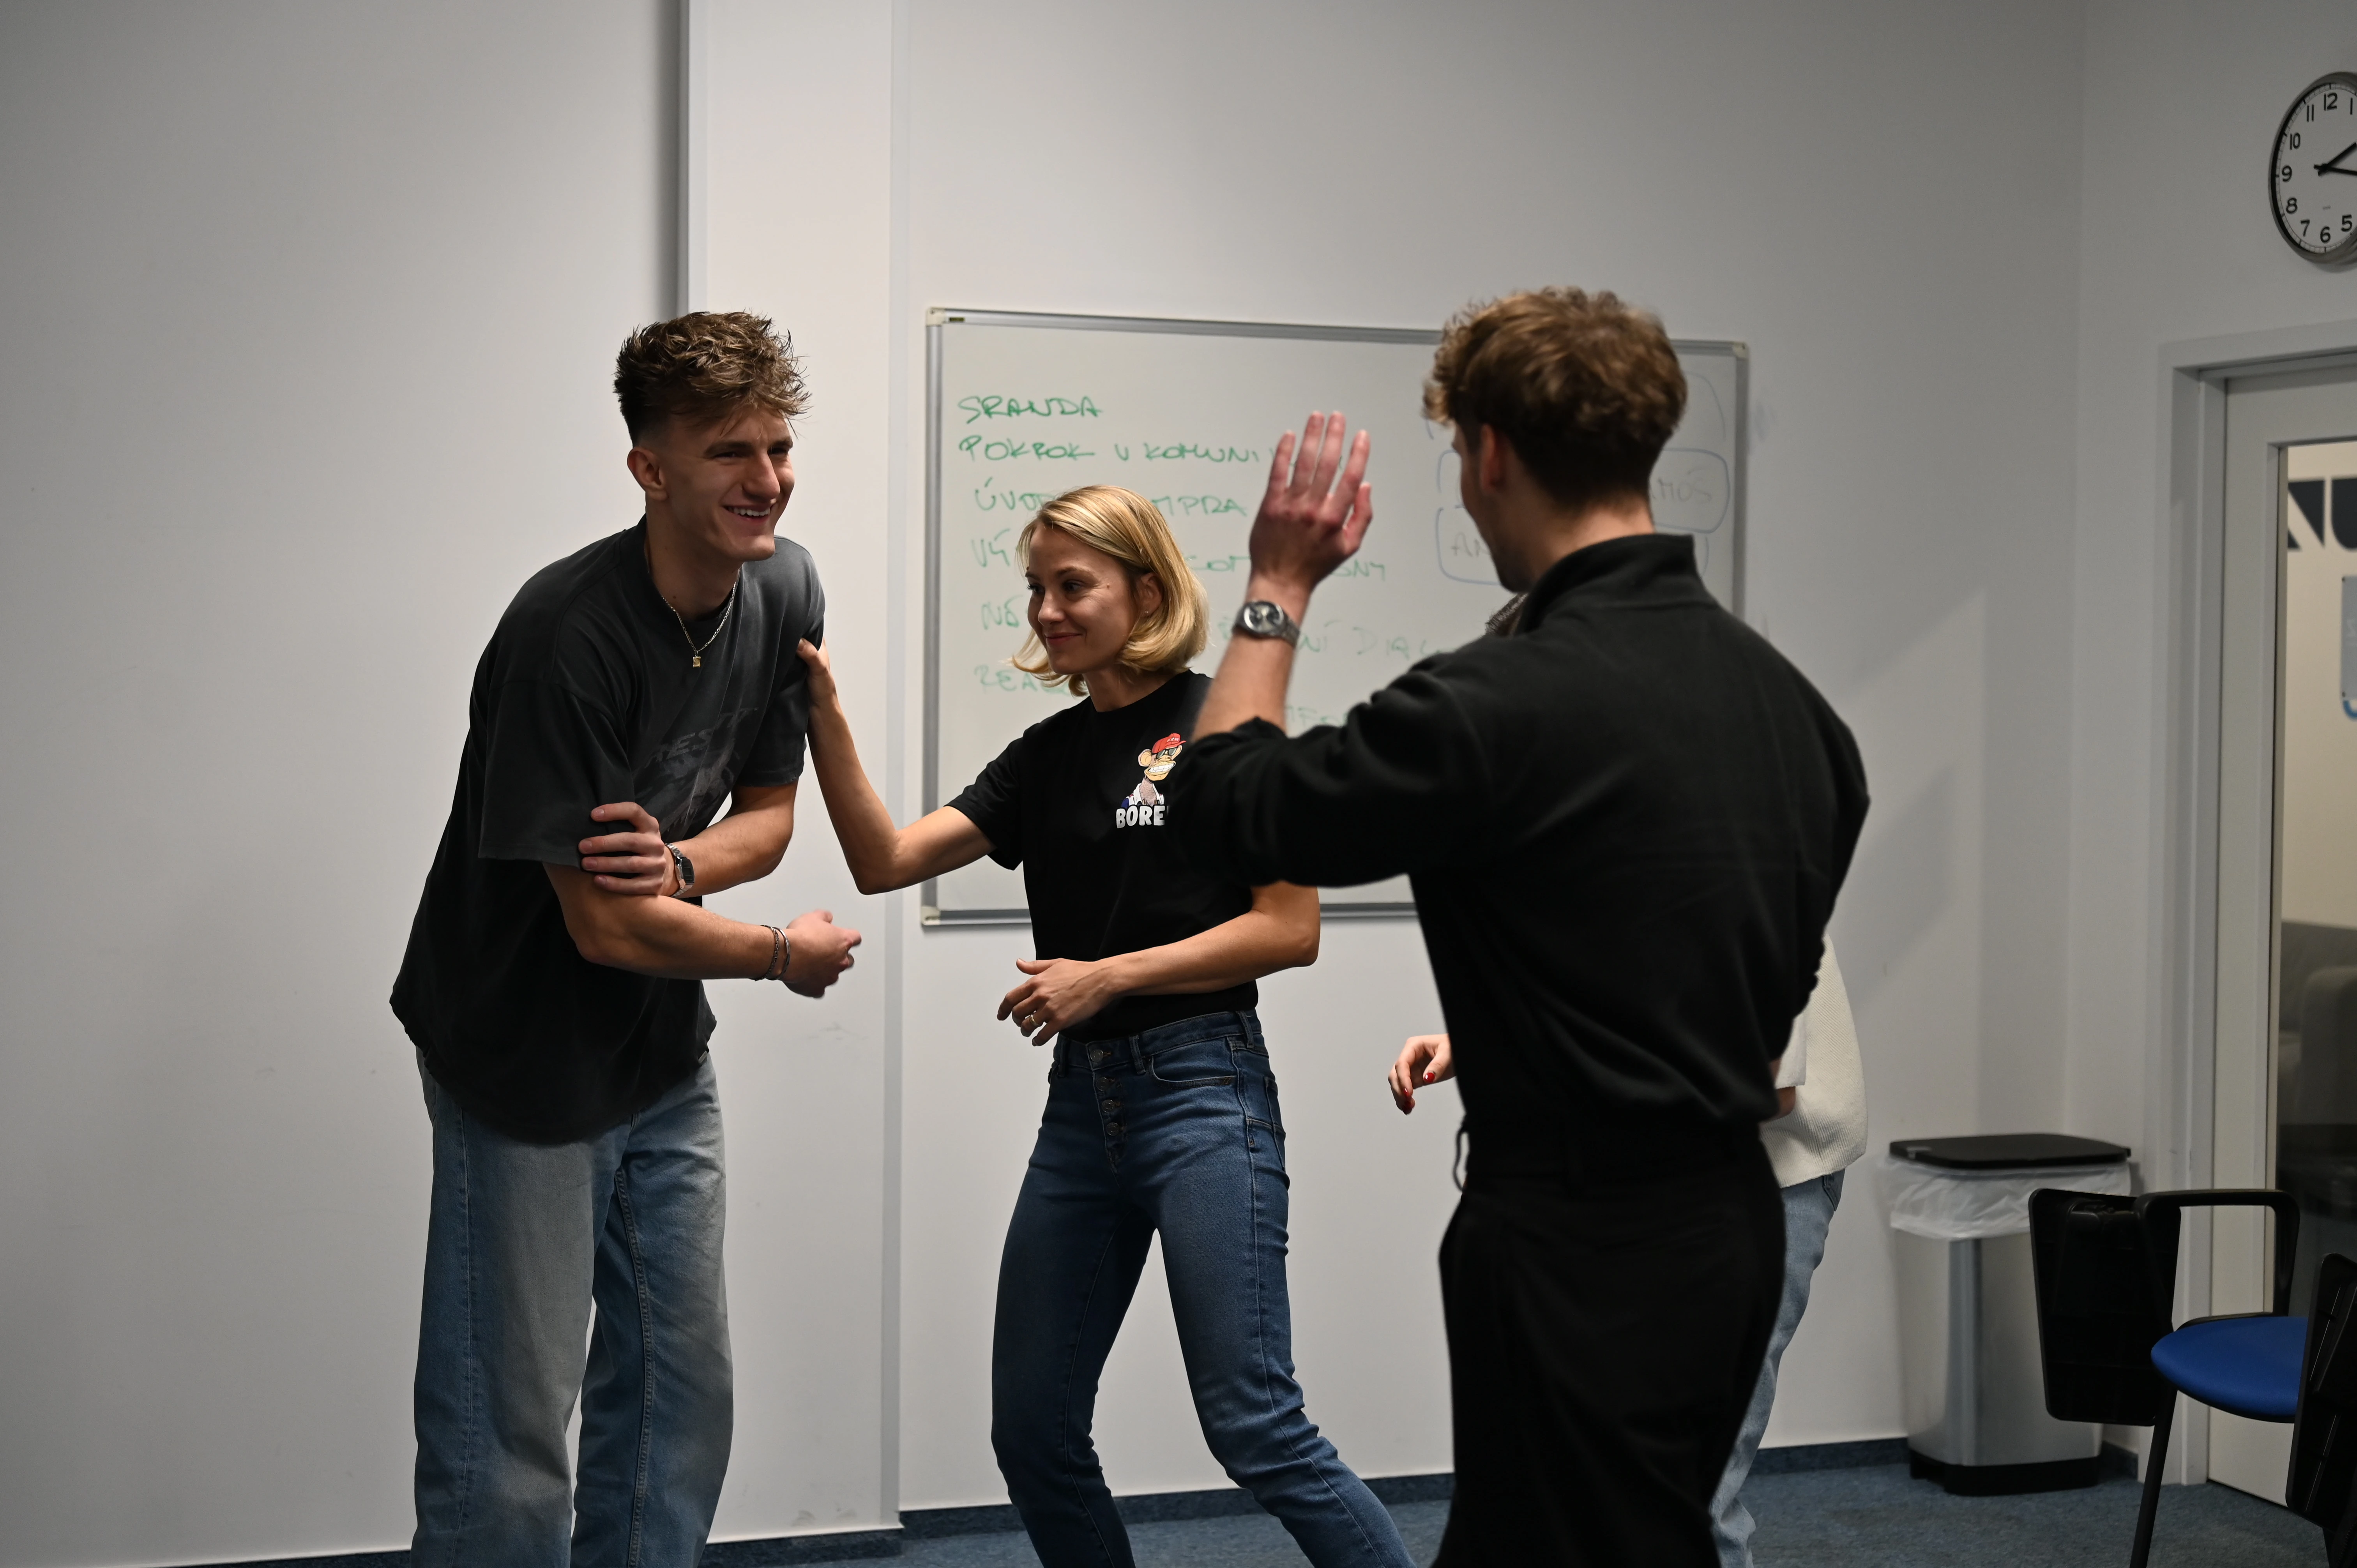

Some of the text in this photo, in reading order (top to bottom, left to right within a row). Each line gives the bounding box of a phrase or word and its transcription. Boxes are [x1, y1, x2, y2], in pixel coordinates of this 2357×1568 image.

[2323, 93, 2338, 111] 12
[2350, 97, 2353, 115] 1
[2306, 104, 2315, 122] 11
[2289, 132, 2301, 150] 10
[2281, 165, 2292, 182] 9
[2286, 197, 2298, 214] 8
[2300, 219, 2310, 237] 7
[2341, 214, 2353, 232] 5
[2320, 226, 2331, 244] 6
[957, 395, 1105, 425] SRANDA
[958, 434, 1097, 463] POKROK
[1143, 441, 1343, 470] KOMUNI
[1116, 805, 1170, 829] BORE
